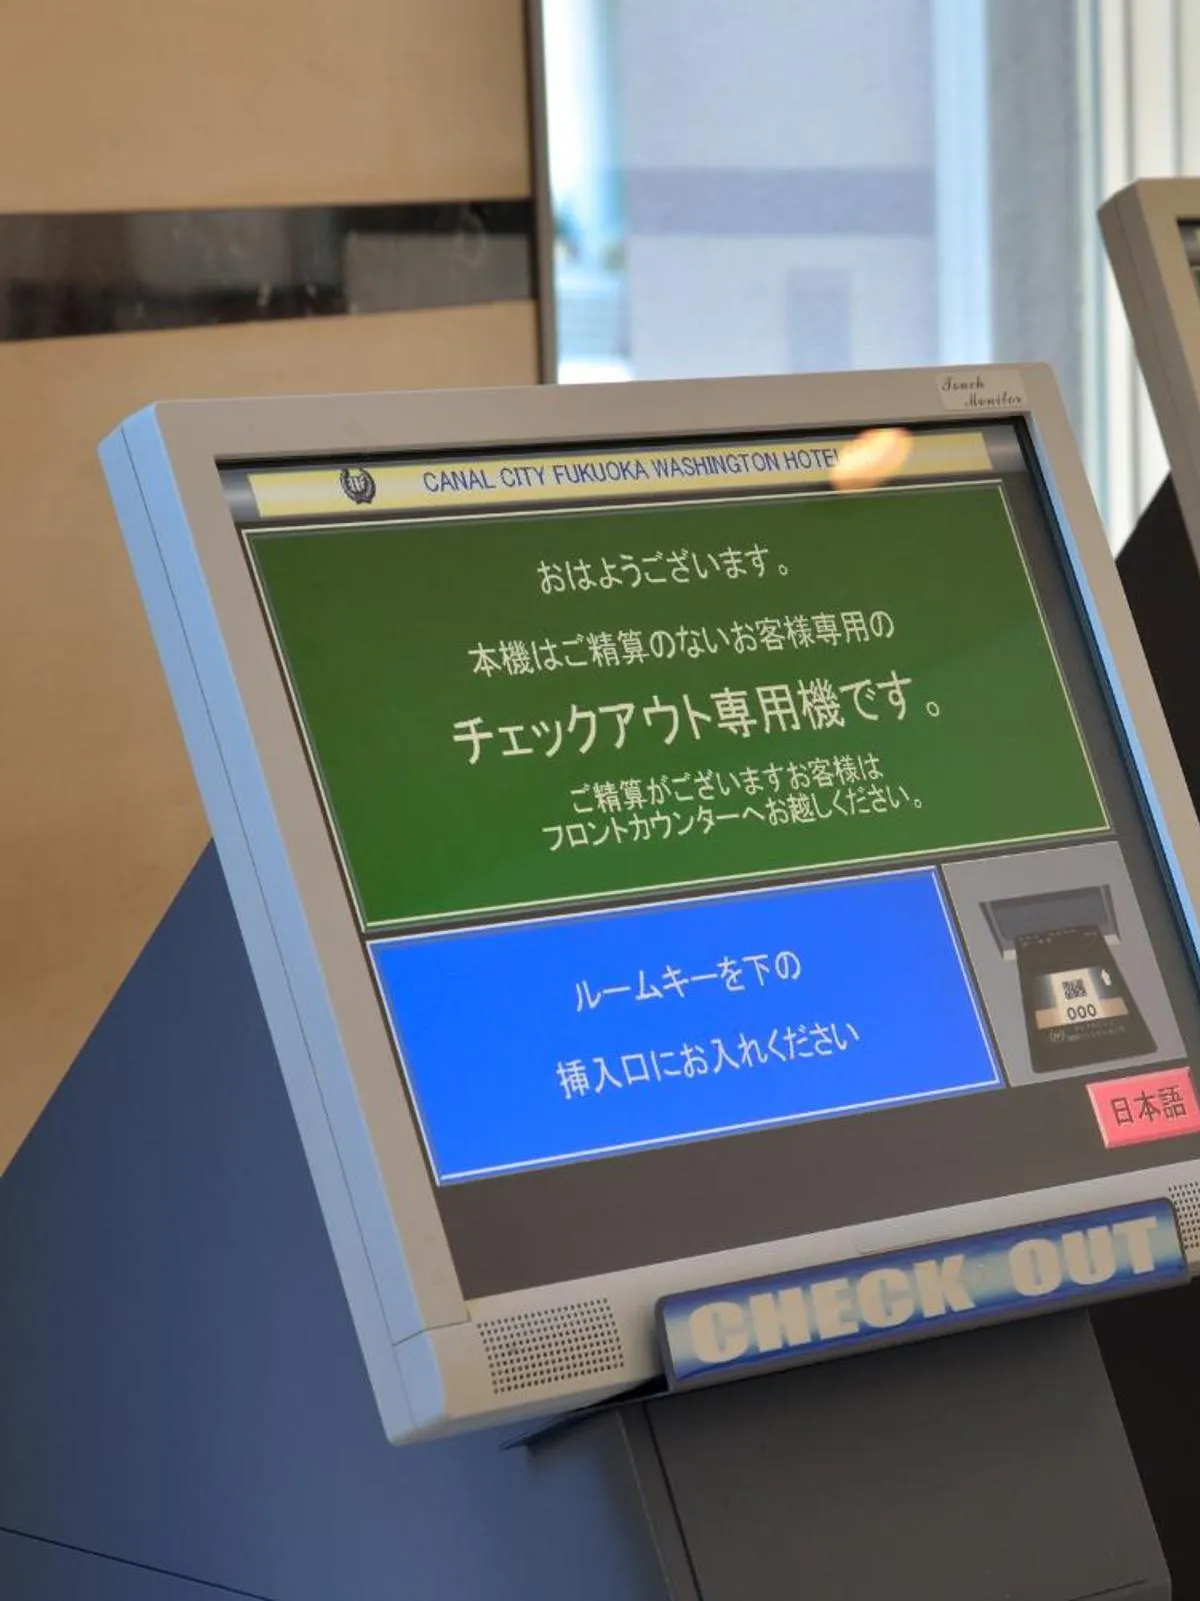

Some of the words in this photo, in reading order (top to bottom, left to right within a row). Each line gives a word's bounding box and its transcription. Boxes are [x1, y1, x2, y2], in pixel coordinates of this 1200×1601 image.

[423, 469, 496, 493] CANAL
[500, 465, 545, 488] CITY
[553, 460, 649, 484] FUKUOKA
[651, 450, 781, 480] WASHINGTON
[536, 543, 788, 595] おはようございます。
[467, 610, 896, 678] 本機はご精算のないお客様専用の
[452, 669, 941, 766] チェックアウト専用機です。
[570, 752, 885, 815] ご精算がございますお客様は
[541, 785, 923, 852] フロントカウンターへお越しください。
[574, 950, 801, 1012] ルームキーを下の
[555, 1022, 860, 1100] 挿入口にお入れください
[1110, 1084, 1187, 1126] 日本語
[688, 1254, 976, 1363] CHECK
[1007, 1216, 1158, 1298] OUT
